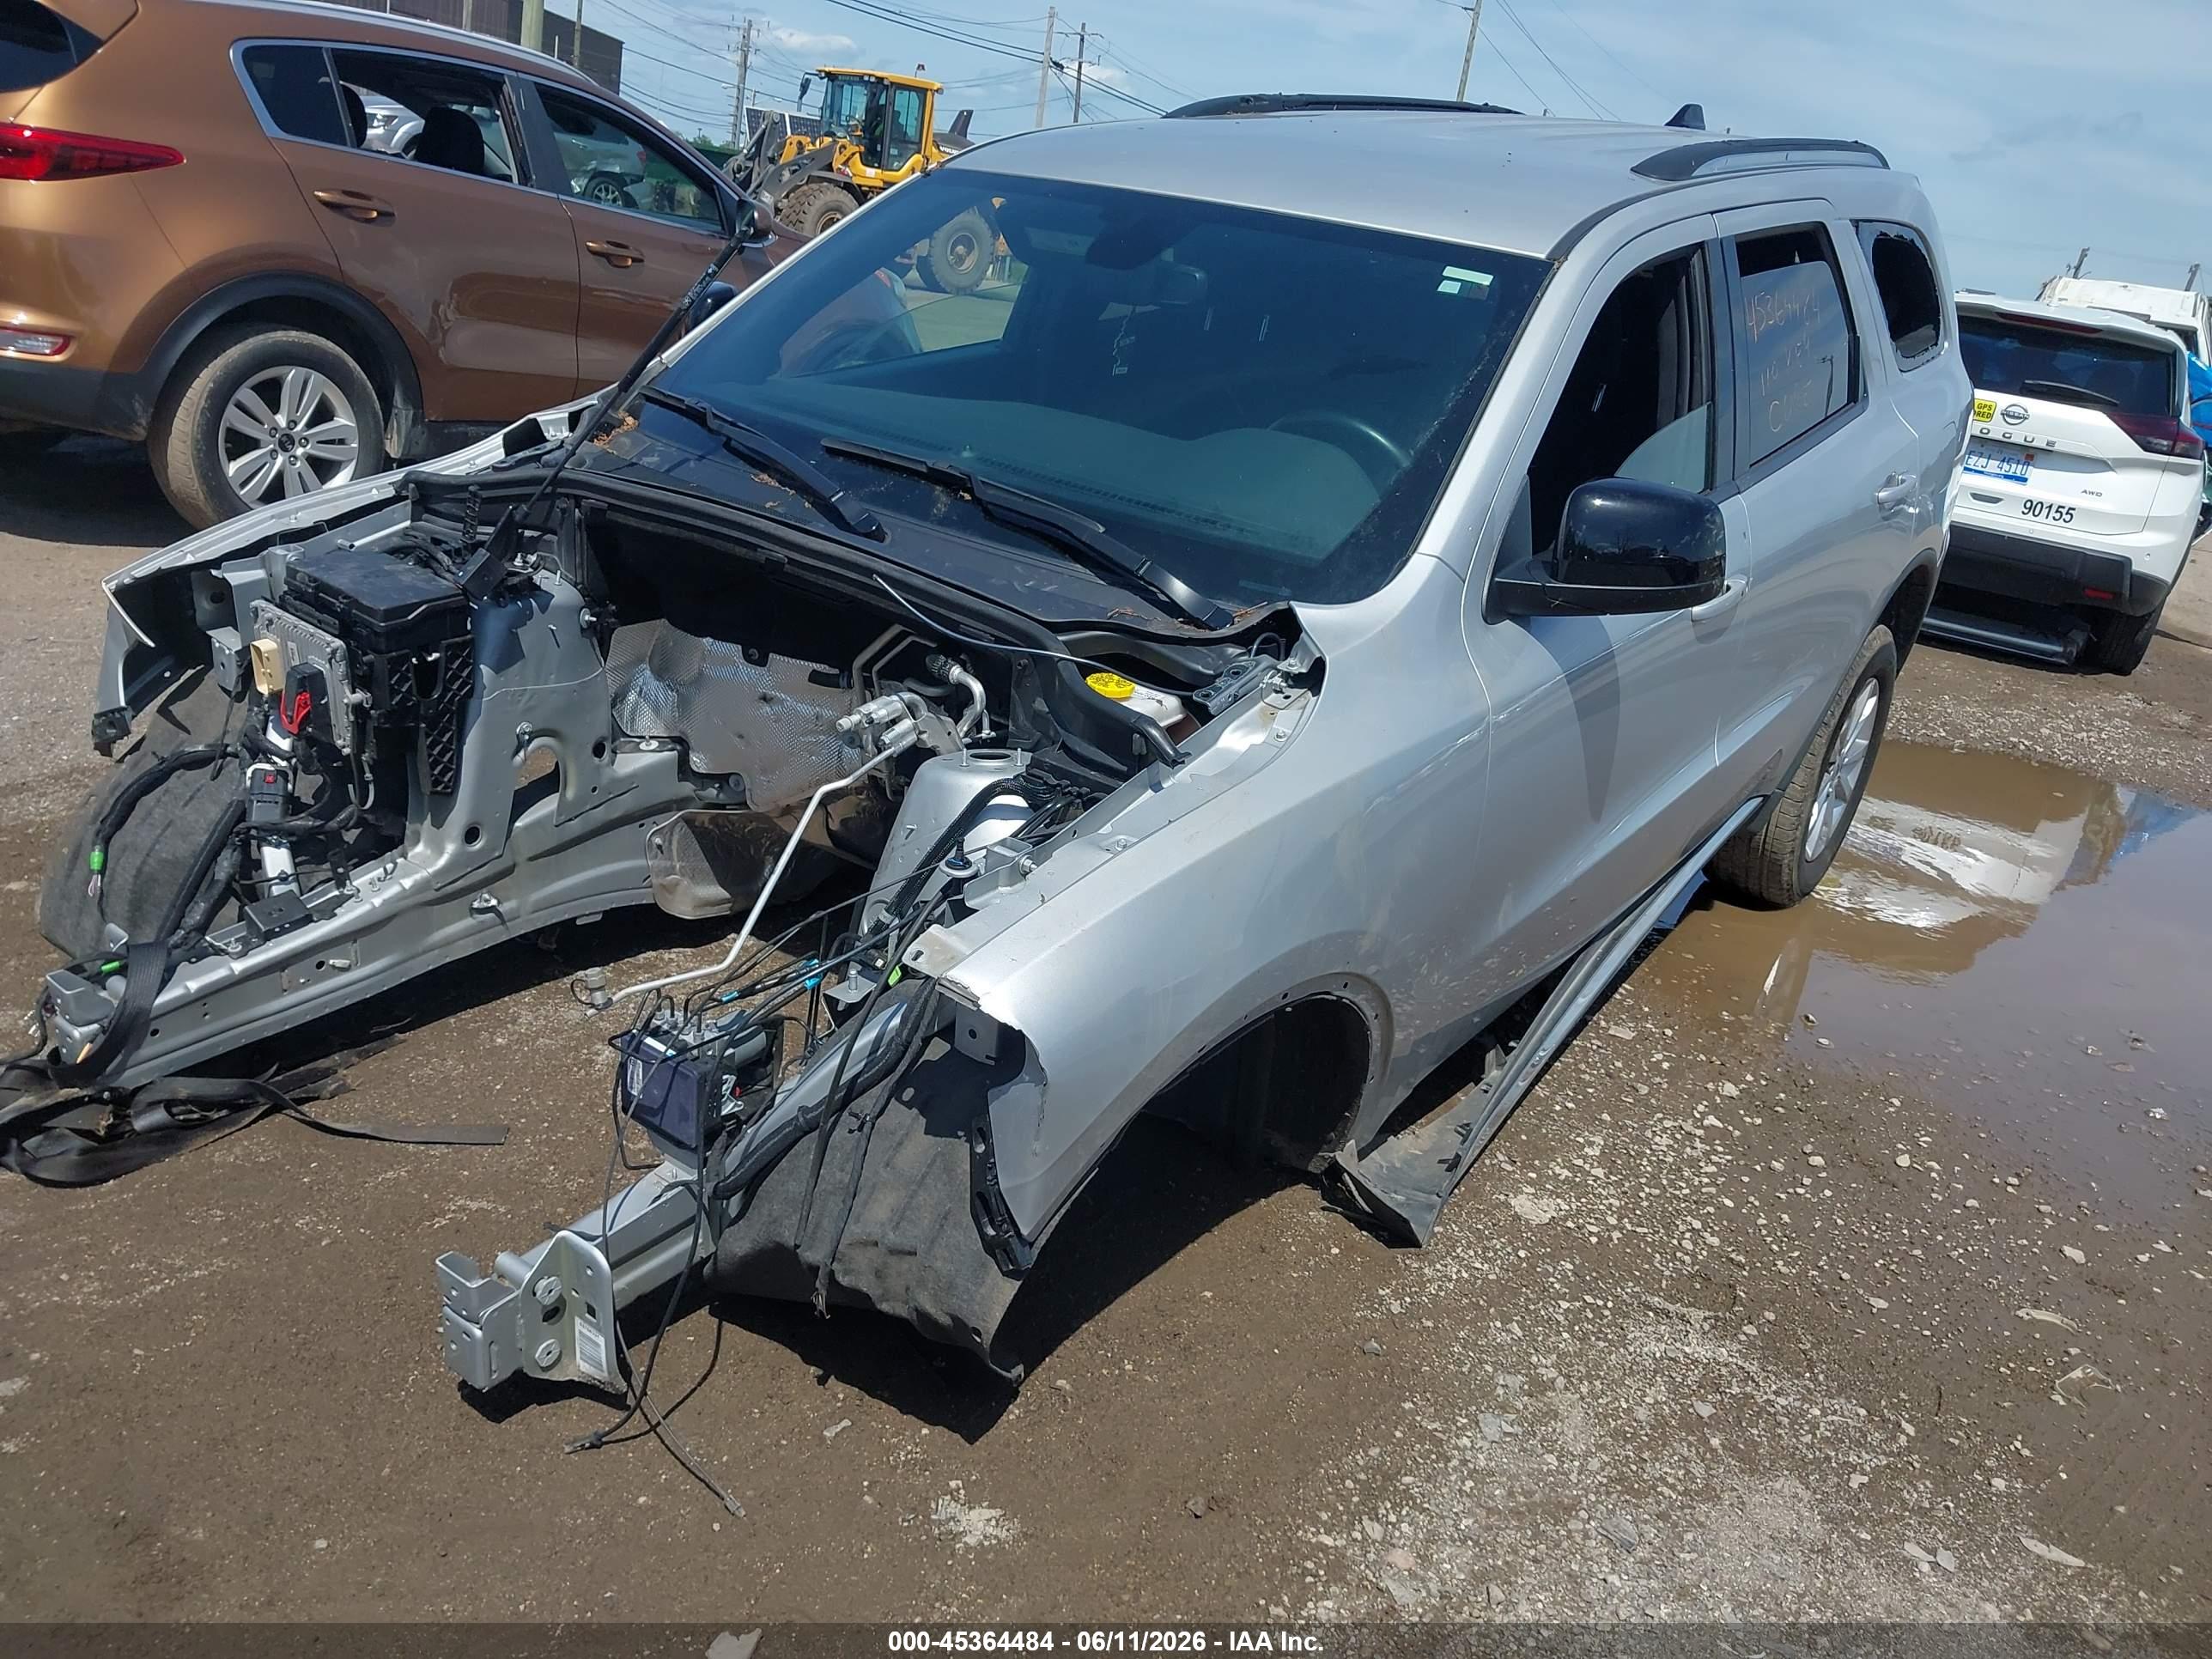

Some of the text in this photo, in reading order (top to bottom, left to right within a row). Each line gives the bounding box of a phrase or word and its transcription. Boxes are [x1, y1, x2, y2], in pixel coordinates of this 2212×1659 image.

[1977, 402, 1993, 411] GPS
[1974, 410, 1992, 419] RED
[1979, 428, 2057, 447] OGUE
[1966, 450, 2030, 476] EZJ 4510
[2081, 489, 2103, 497] AWD
[2021, 499, 2076, 524] 90155
